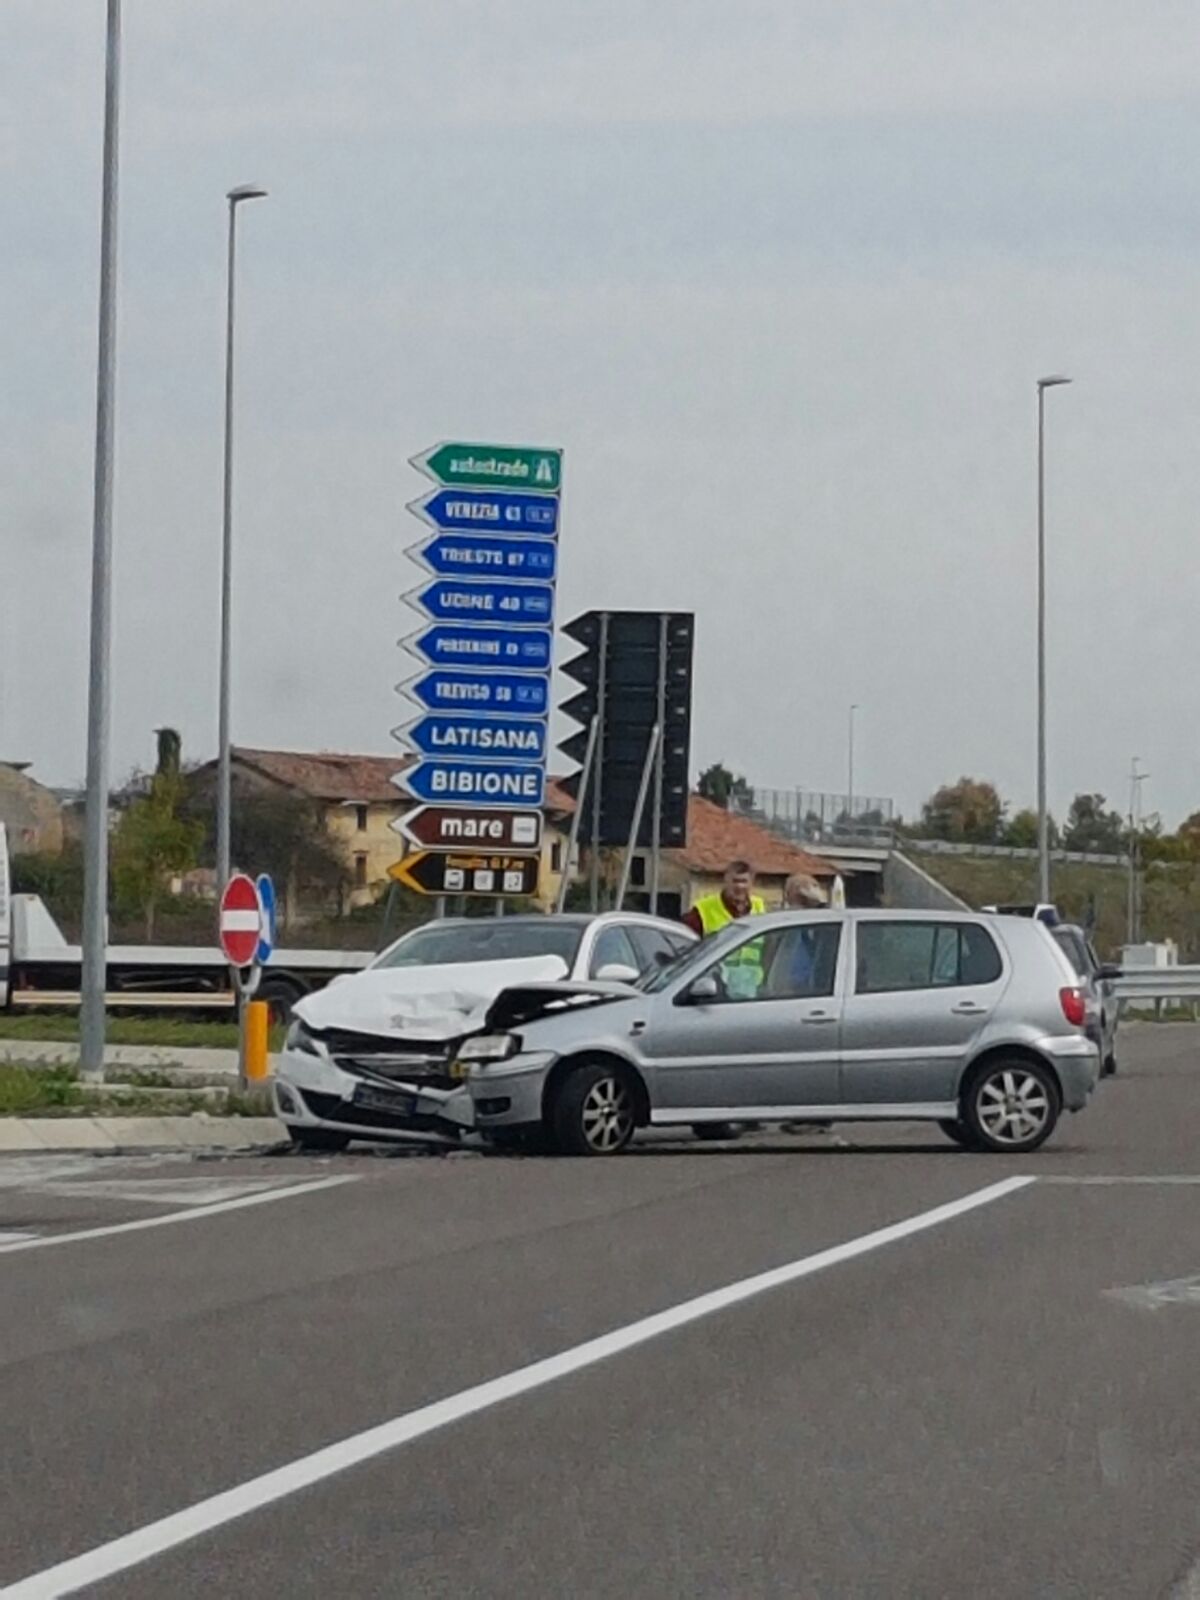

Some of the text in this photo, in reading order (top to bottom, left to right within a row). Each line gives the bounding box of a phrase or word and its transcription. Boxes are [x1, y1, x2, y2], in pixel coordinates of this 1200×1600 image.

[431, 726, 539, 750] LATISANA
[431, 770, 538, 796] BIBIONE
[441, 817, 503, 837] mare
